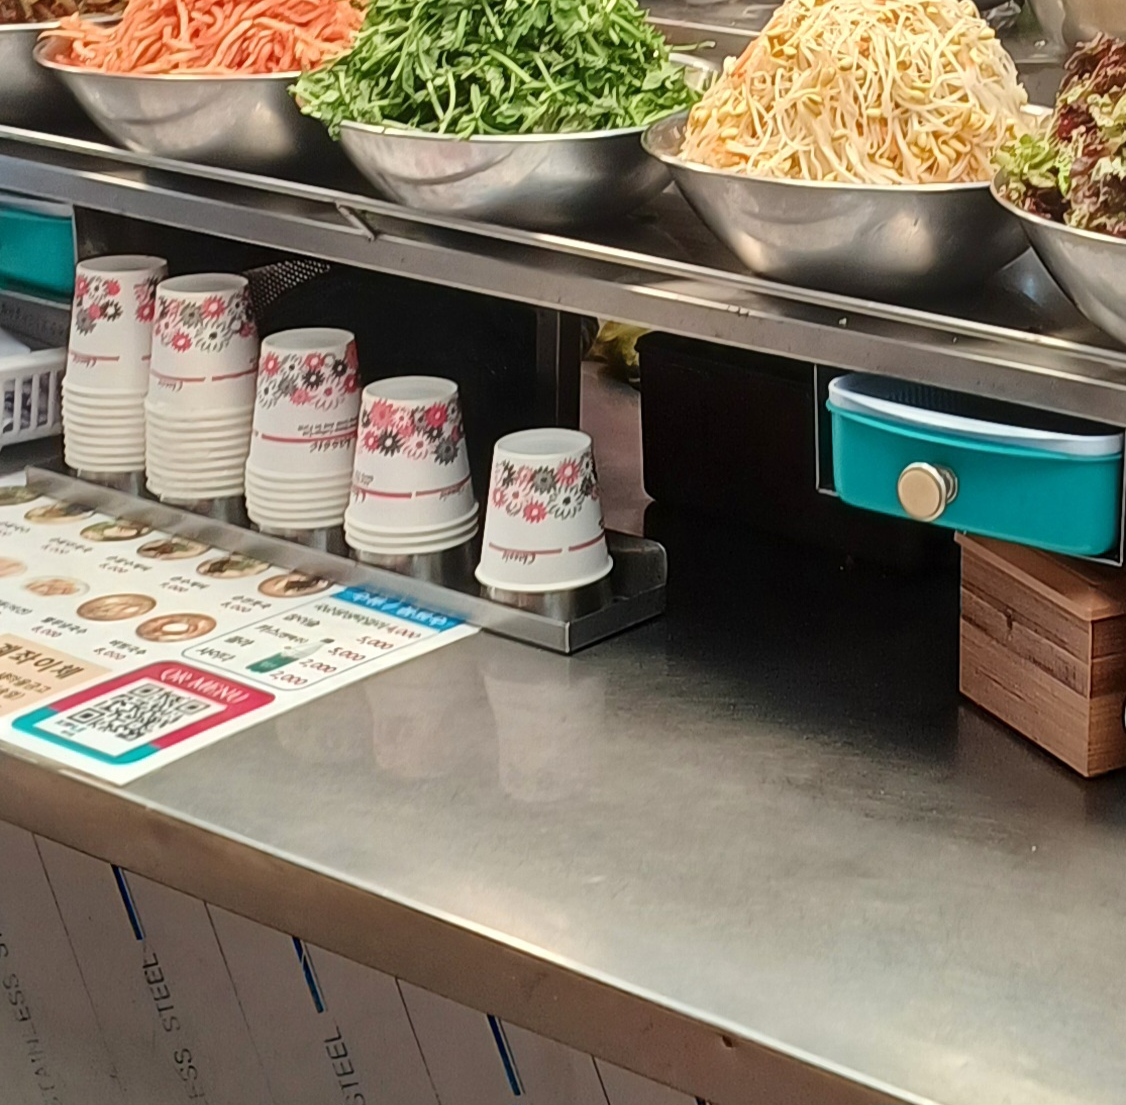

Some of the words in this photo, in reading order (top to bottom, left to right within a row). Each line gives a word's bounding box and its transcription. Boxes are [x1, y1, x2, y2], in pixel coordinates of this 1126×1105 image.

[309, 437, 353, 453] lassic
[501, 550, 537, 566] Classic
[328, 645, 366, 662] 5,000
[299, 658, 337, 674] 2,000
[269, 670, 309, 686] 2,000
[142, 952, 182, 1033] STEEL
